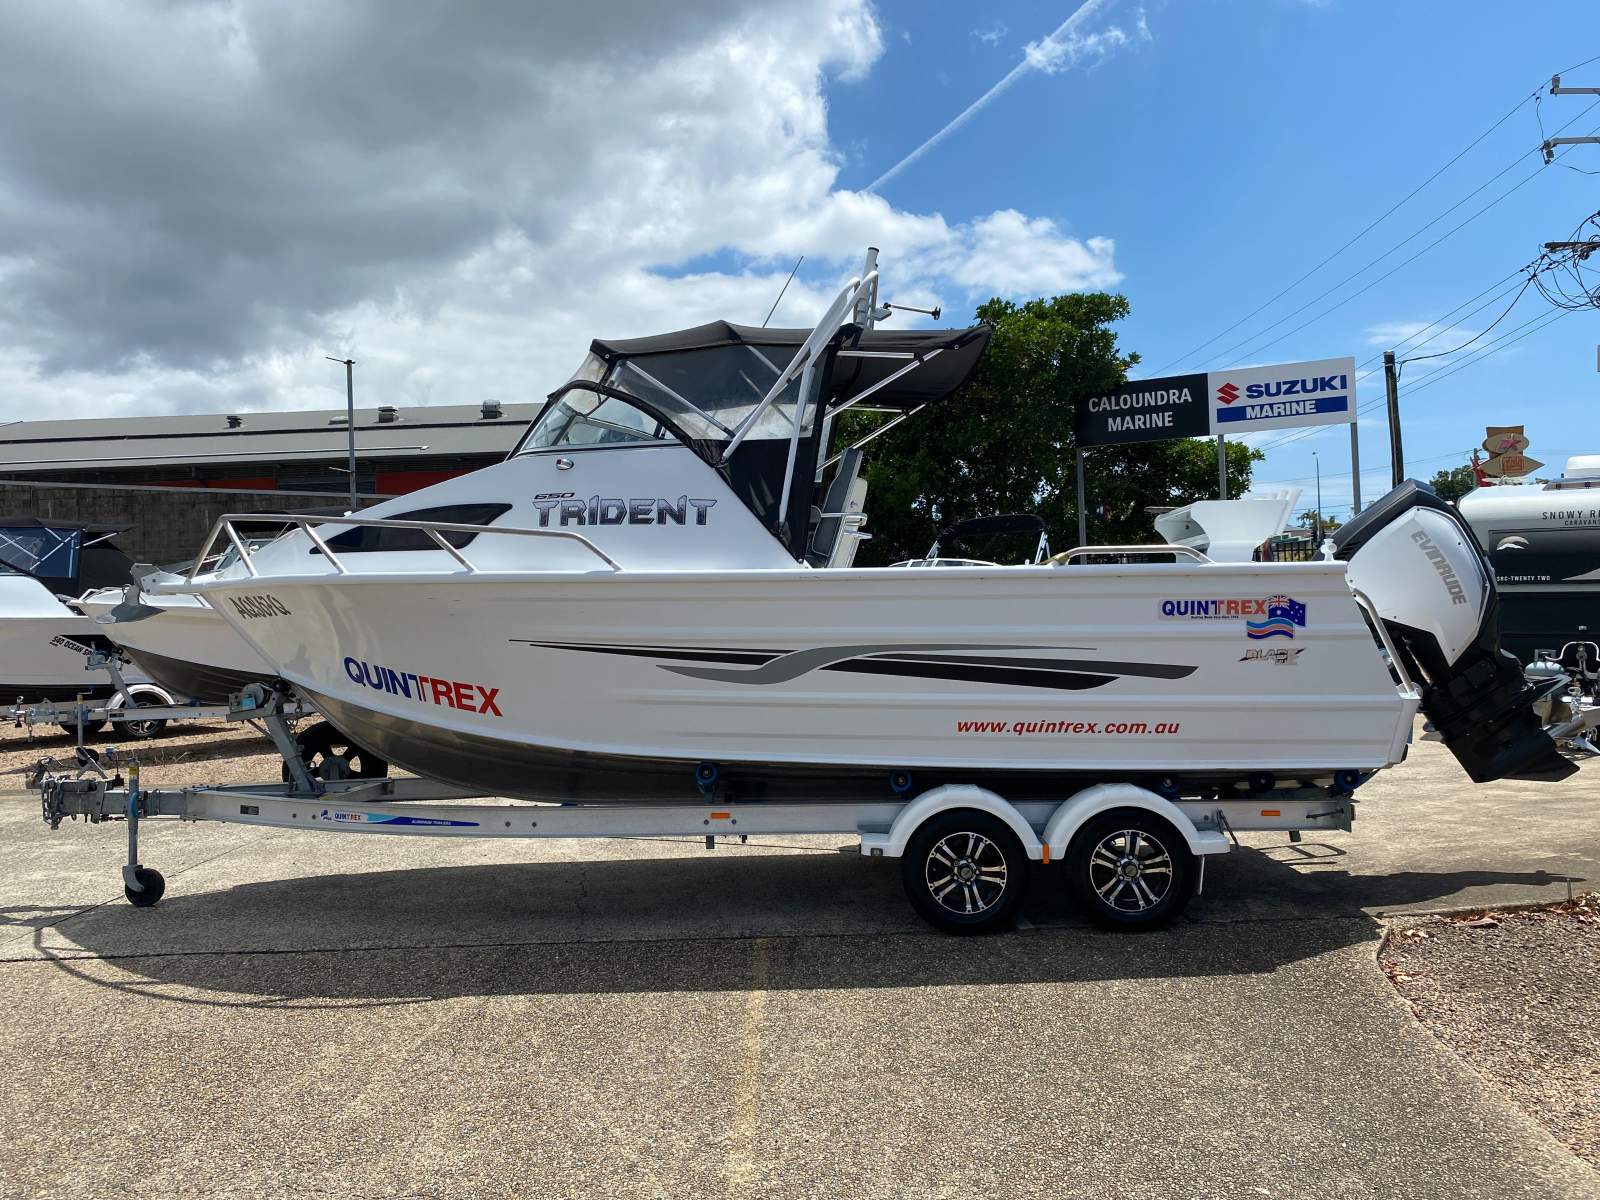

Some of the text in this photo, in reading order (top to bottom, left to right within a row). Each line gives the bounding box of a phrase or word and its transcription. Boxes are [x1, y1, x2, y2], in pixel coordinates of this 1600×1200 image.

[1246, 374, 1348, 400] SUZUKI
[1088, 387, 1193, 413] CALOUNDRA
[1245, 400, 1317, 419] MARINE
[1107, 411, 1174, 432] MARINE
[534, 492, 575, 500] 650
[532, 494, 718, 527] TRIDENT
[1542, 510, 1584, 520] SNOWY
[1411, 530, 1467, 605] EVINRUDE
[1162, 599, 1268, 616] QUINTREX
[64, 640, 83, 653] OCEAN
[343, 656, 503, 717] QUINTREX
[957, 719, 1181, 735] www.quintrex.com.au
